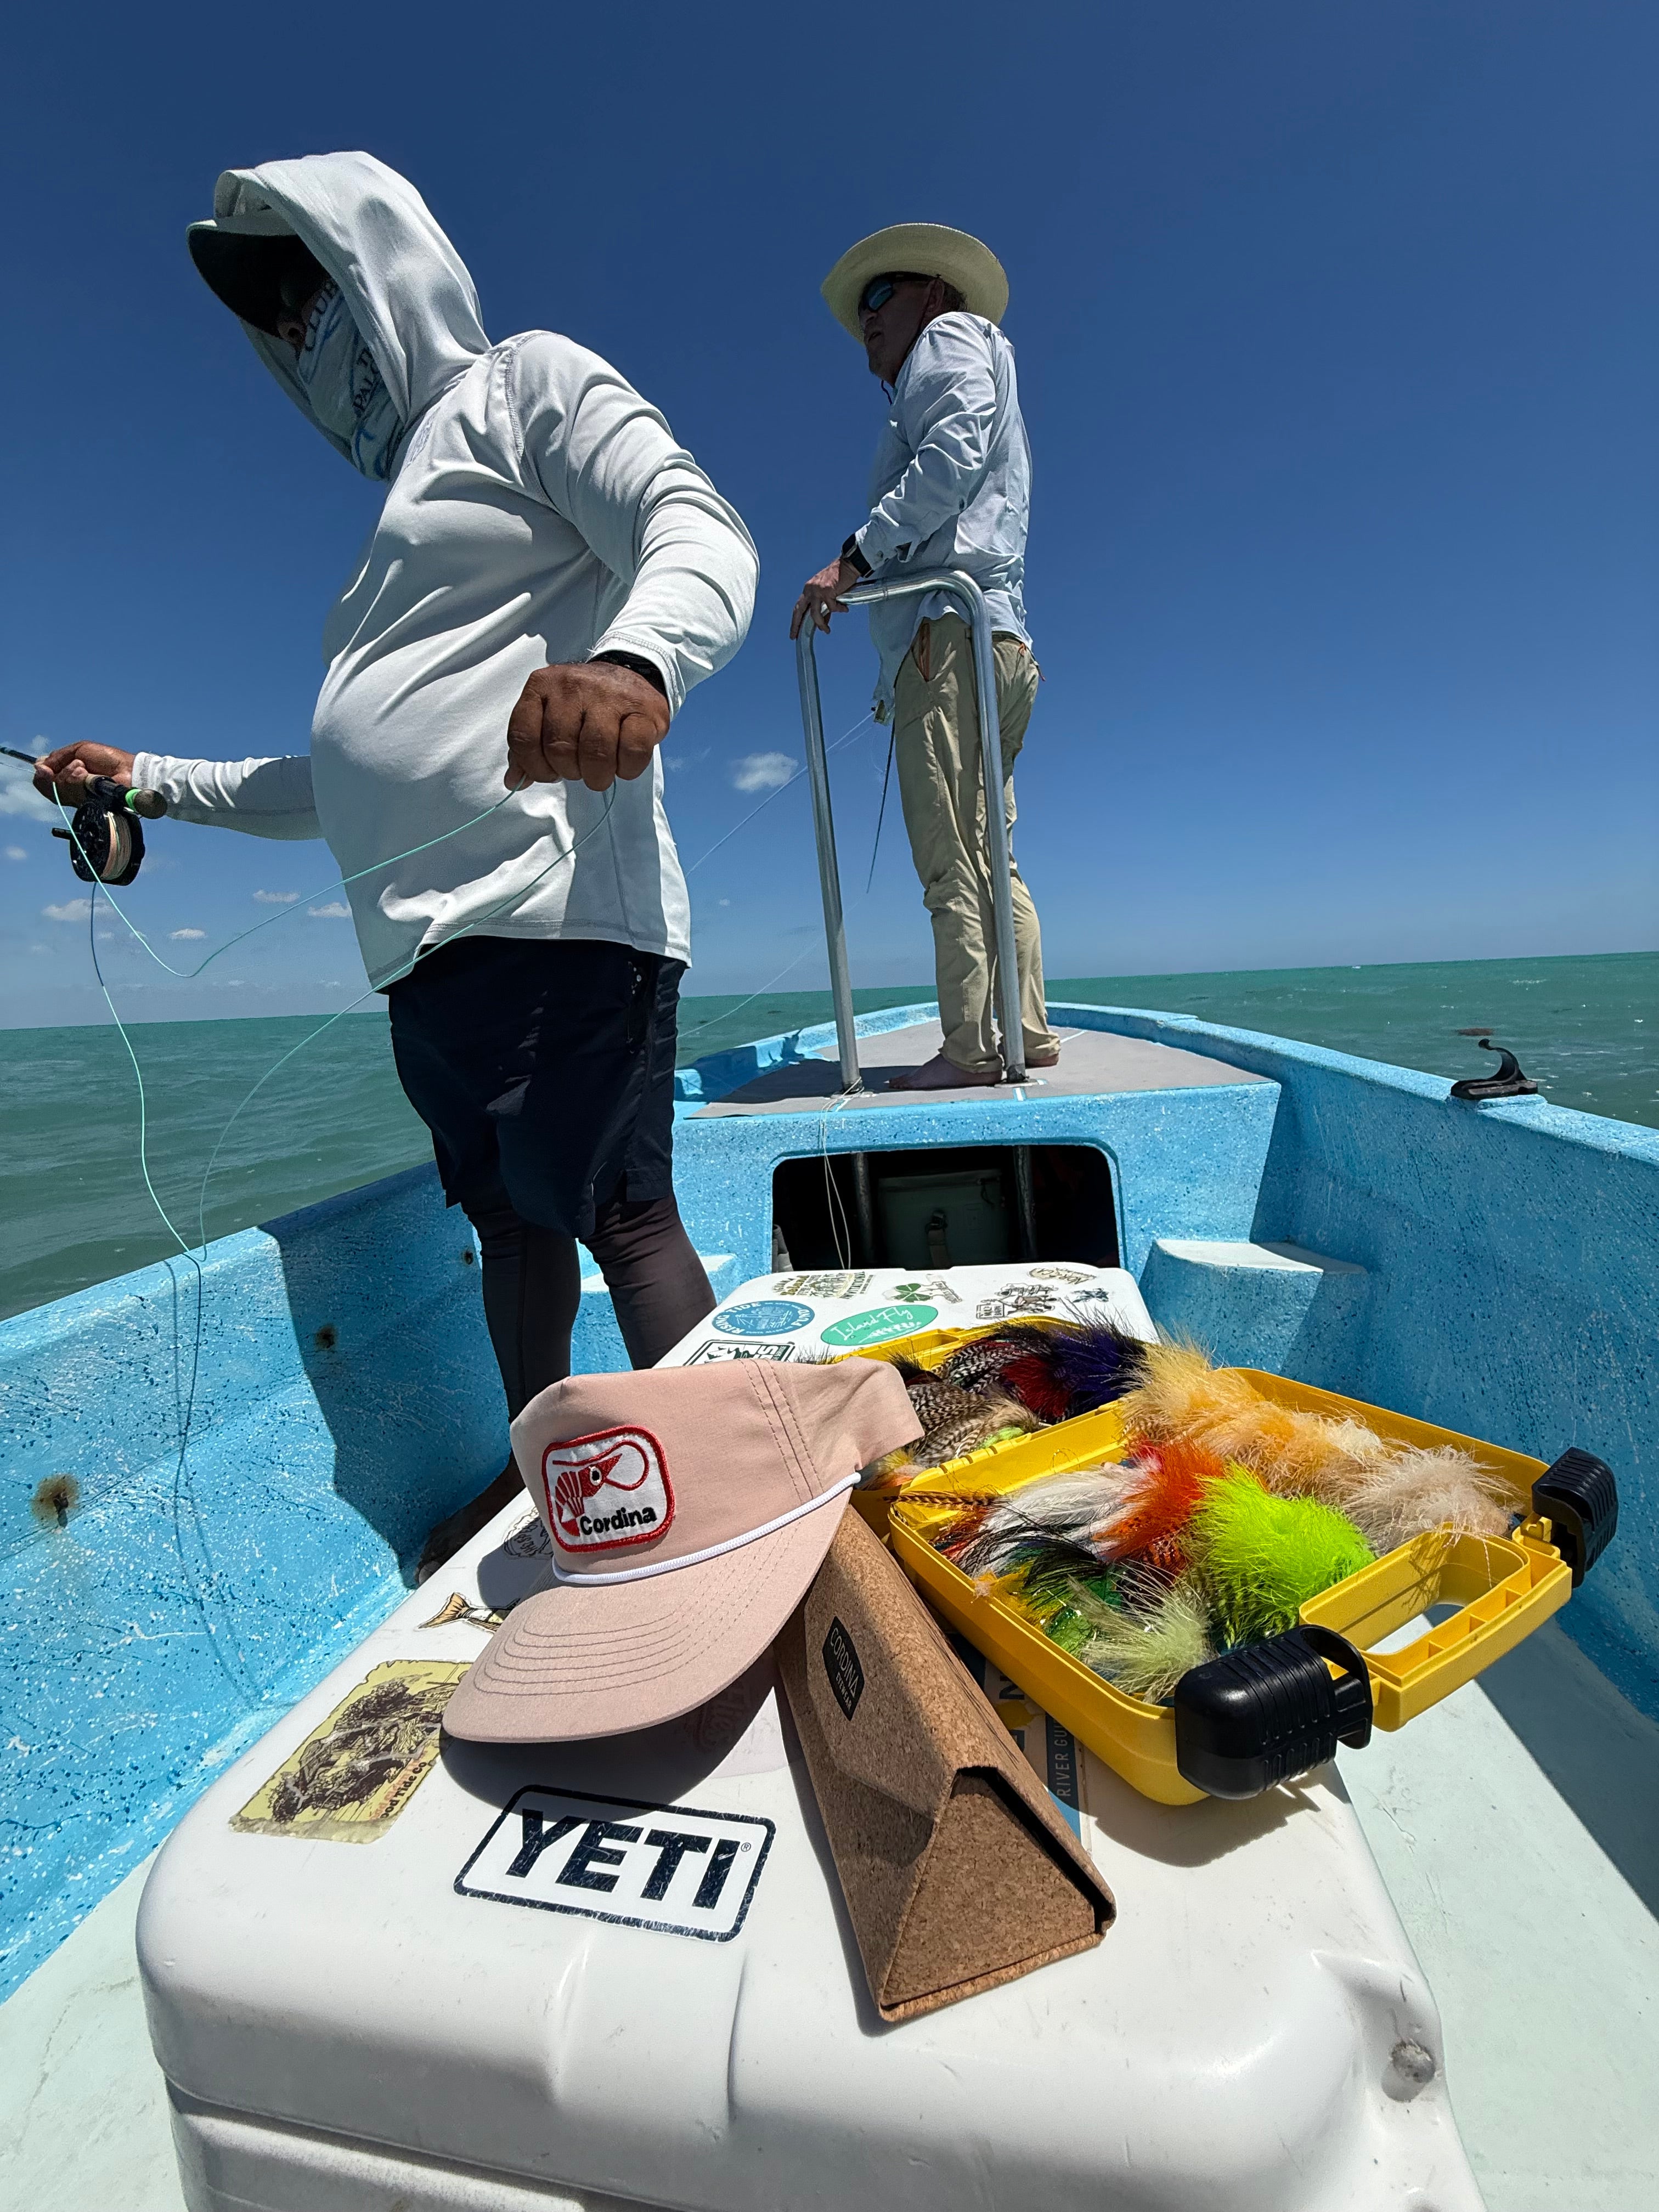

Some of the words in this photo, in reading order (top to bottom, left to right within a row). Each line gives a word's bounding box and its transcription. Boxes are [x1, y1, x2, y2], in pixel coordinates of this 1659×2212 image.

[715, 1314, 746, 1335] RISING
[726, 1302, 761, 1313] TIDE
[791, 1309, 811, 1327] FUND
[830, 1314, 879, 1341] Island
[876, 1307, 913, 1323] Fly
[580, 1507, 657, 1535] Cordina
[830, 1627, 859, 1698] CORDINA
[836, 1672, 852, 1710] EYEWEAR
[393, 1775, 417, 1797] Tide
[413, 1762, 427, 1774] Co
[1056, 1753, 1071, 1797] RIVER
[505, 1808, 740, 1910] YETI
